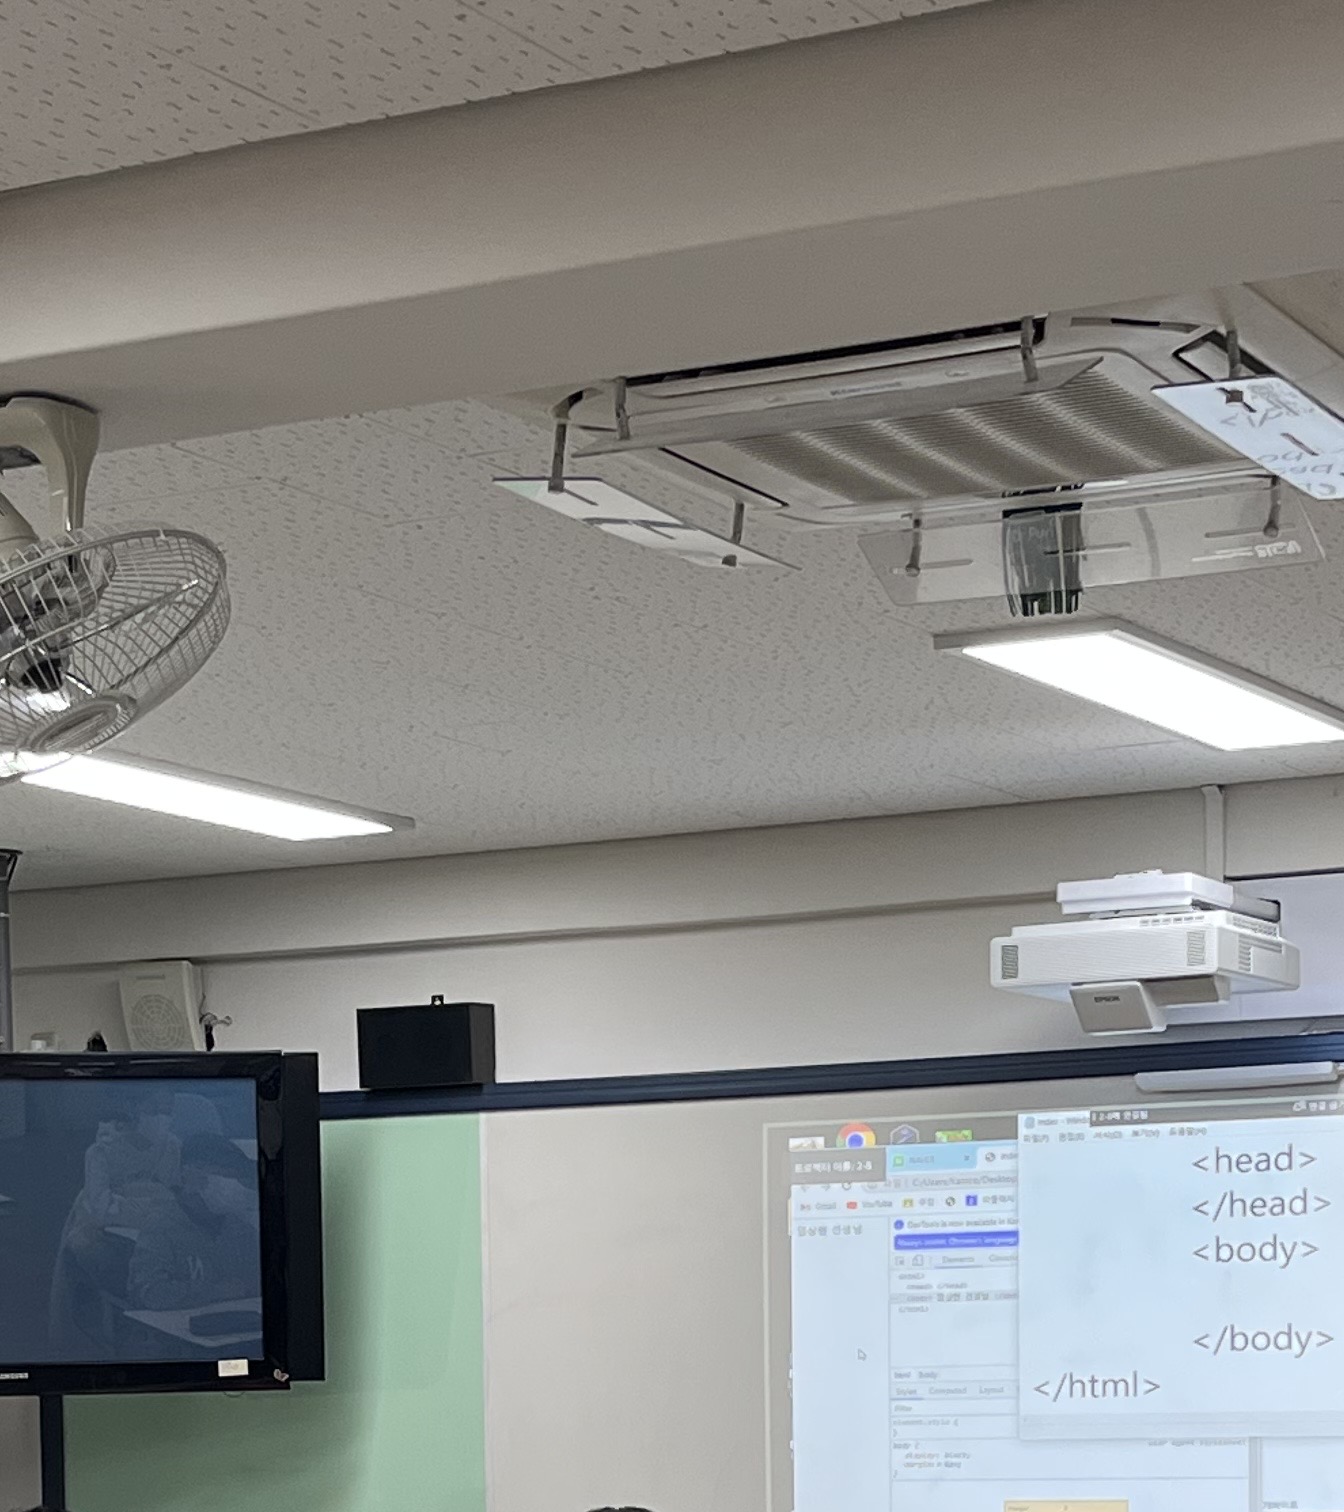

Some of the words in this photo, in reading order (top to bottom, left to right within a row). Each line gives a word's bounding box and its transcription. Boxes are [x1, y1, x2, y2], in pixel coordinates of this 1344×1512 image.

[1192, 1143, 1318, 1174] <head>
[1192, 1187, 1332, 1223] </head>
[1192, 1234, 1320, 1270] <body>
[1192, 1323, 1335, 1358] </body>
[1032, 1371, 1161, 1403] </html>
